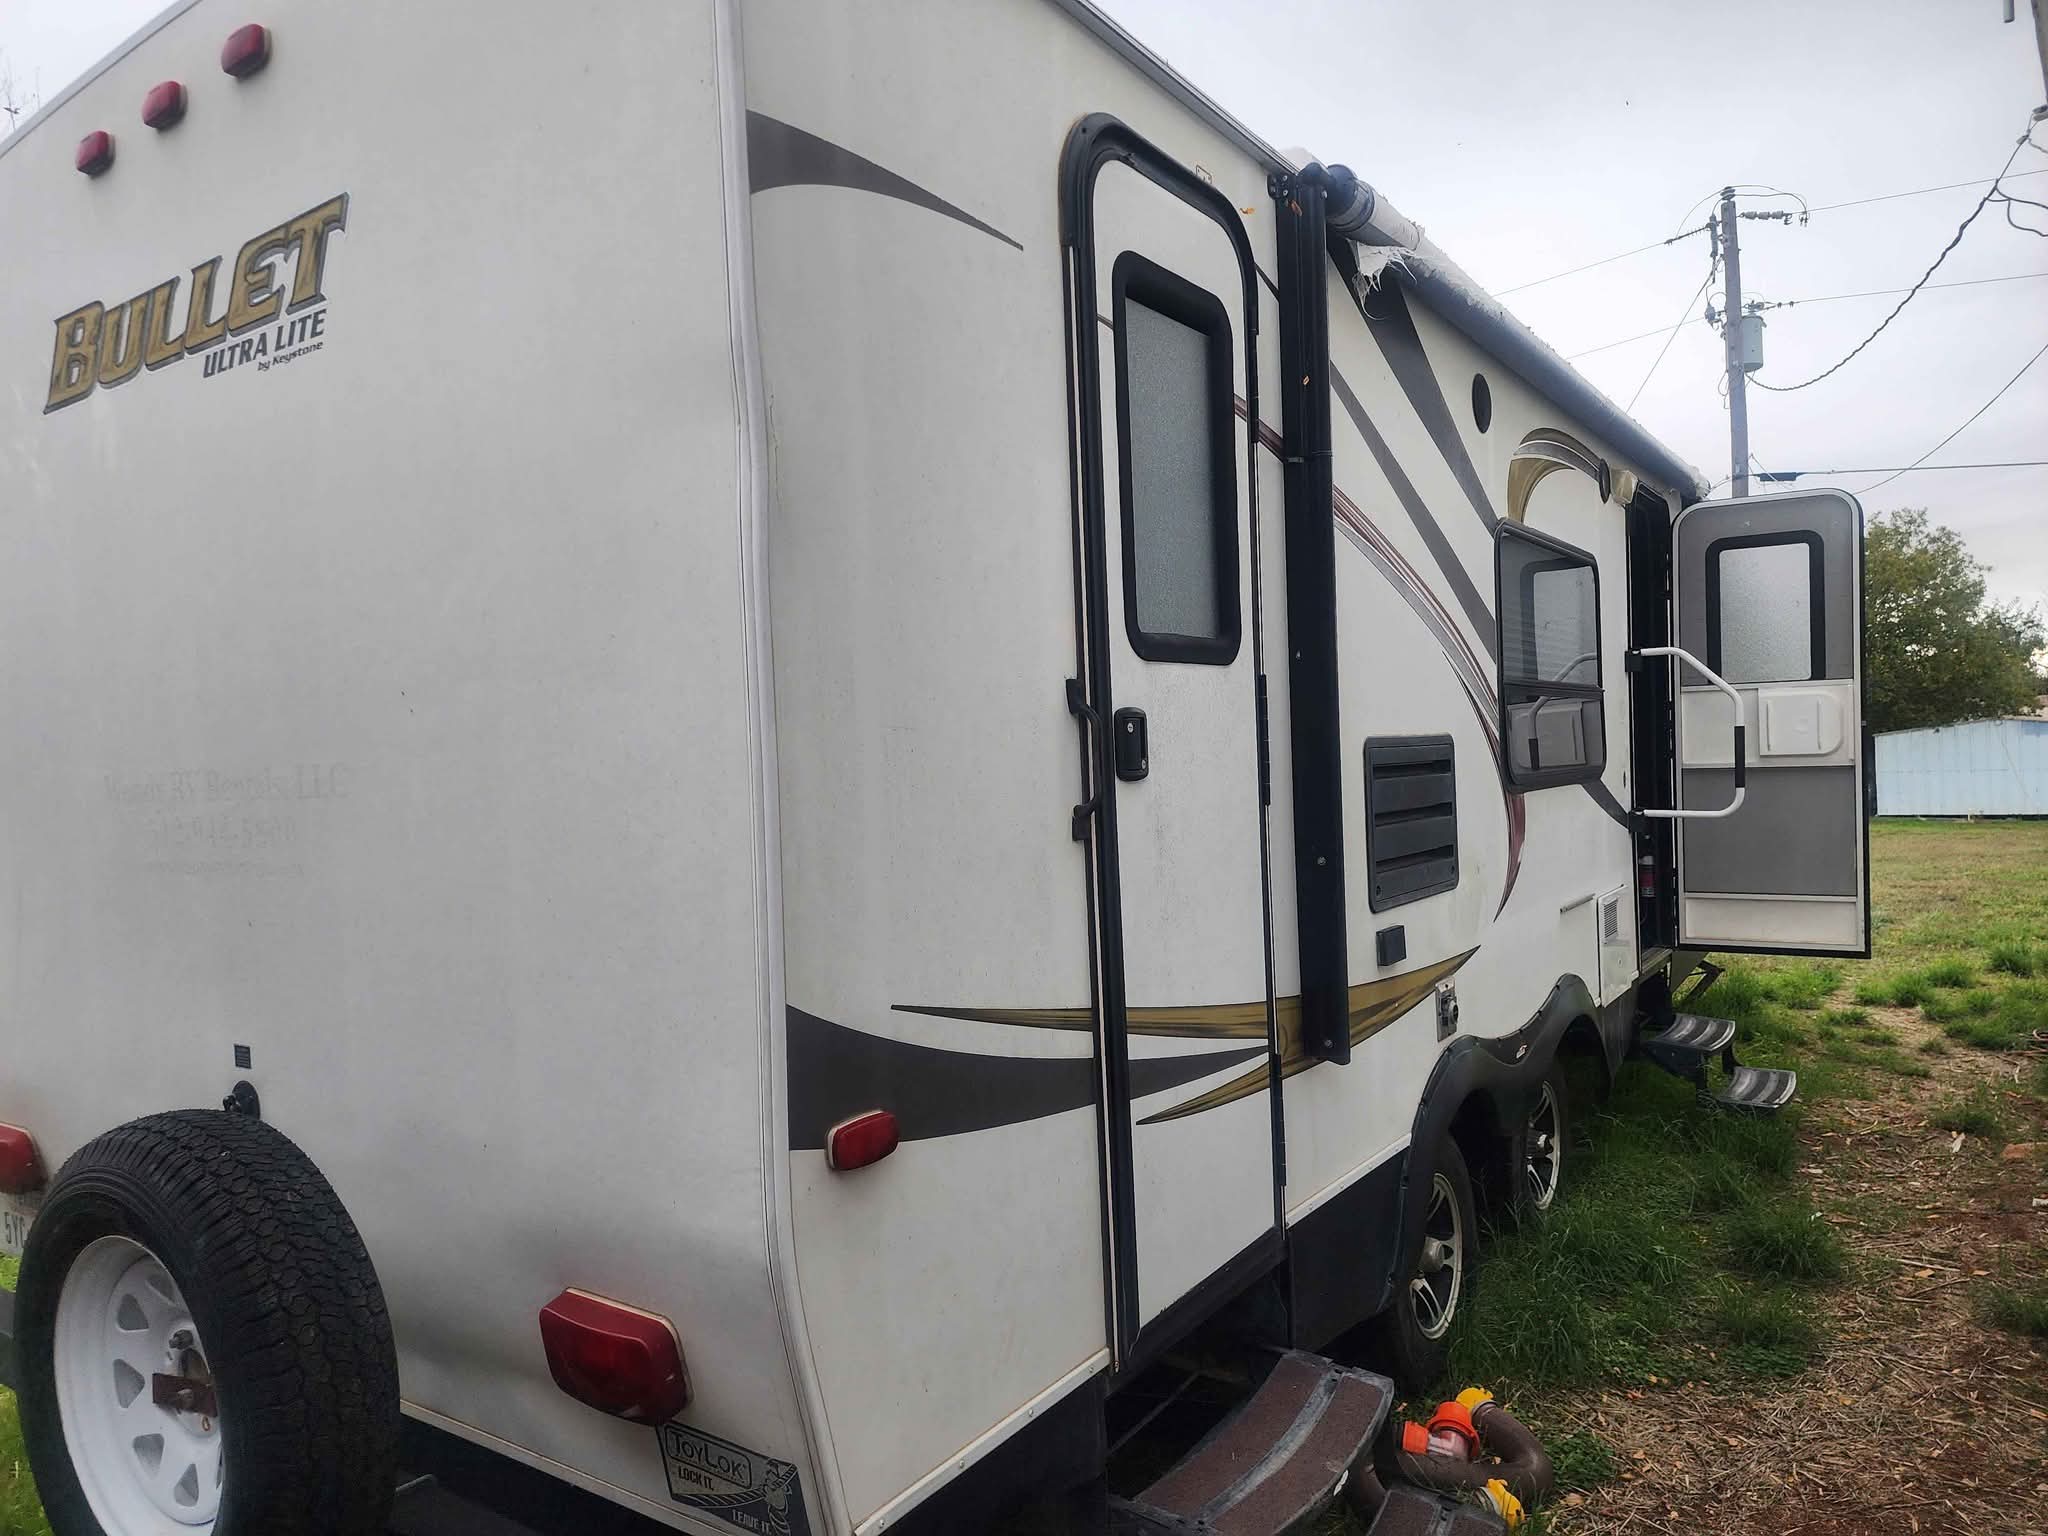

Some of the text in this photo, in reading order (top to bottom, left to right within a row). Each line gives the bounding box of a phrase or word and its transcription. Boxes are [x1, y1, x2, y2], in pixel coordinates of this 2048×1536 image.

[42, 191, 350, 415] BULLET
[203, 308, 328, 379] ULTRA LITE
[257, 341, 324, 372] by Keystone
[678, 1466, 703, 1487] LOCK
[731, 1509, 762, 1529] LEAVE
